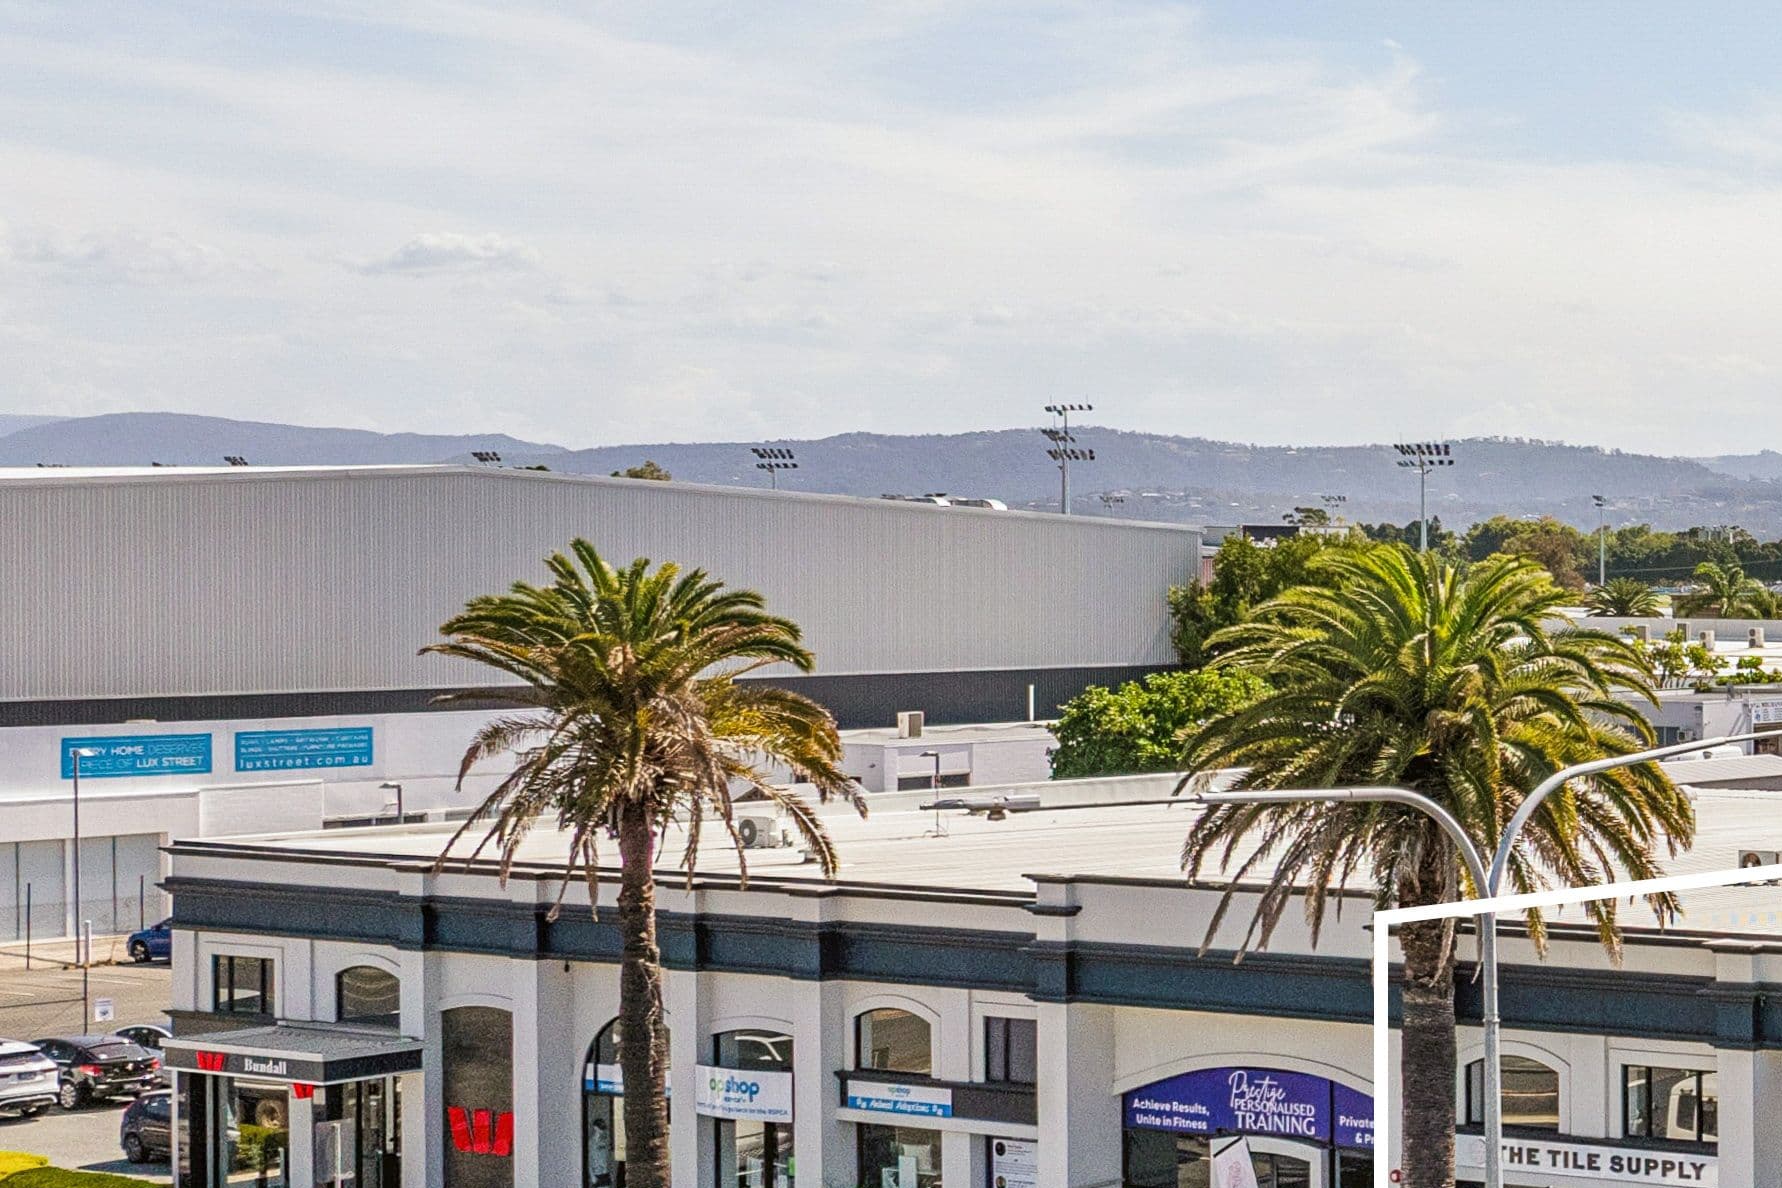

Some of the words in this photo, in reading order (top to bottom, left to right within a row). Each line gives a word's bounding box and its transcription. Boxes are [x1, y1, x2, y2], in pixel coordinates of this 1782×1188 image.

[111, 745, 144, 756] HOME
[137, 757, 159, 768] LUX
[162, 755, 203, 767] STREET
[244, 1057, 287, 1075] Bundall
[1228, 1070, 1287, 1110] Prestige
[1132, 1098, 1171, 1111] Achieve
[1234, 1098, 1315, 1117] PERSONALISED
[1136, 1113, 1161, 1125] Unite
[1162, 1115, 1172, 1126] in
[1173, 1116, 1208, 1130] Fitness
[1234, 1110, 1316, 1136] TRAINING
[1355, 1133, 1363, 1144] &
[1548, 1149, 1601, 1171] TILE
[1609, 1154, 1706, 1180] SUPPLY
